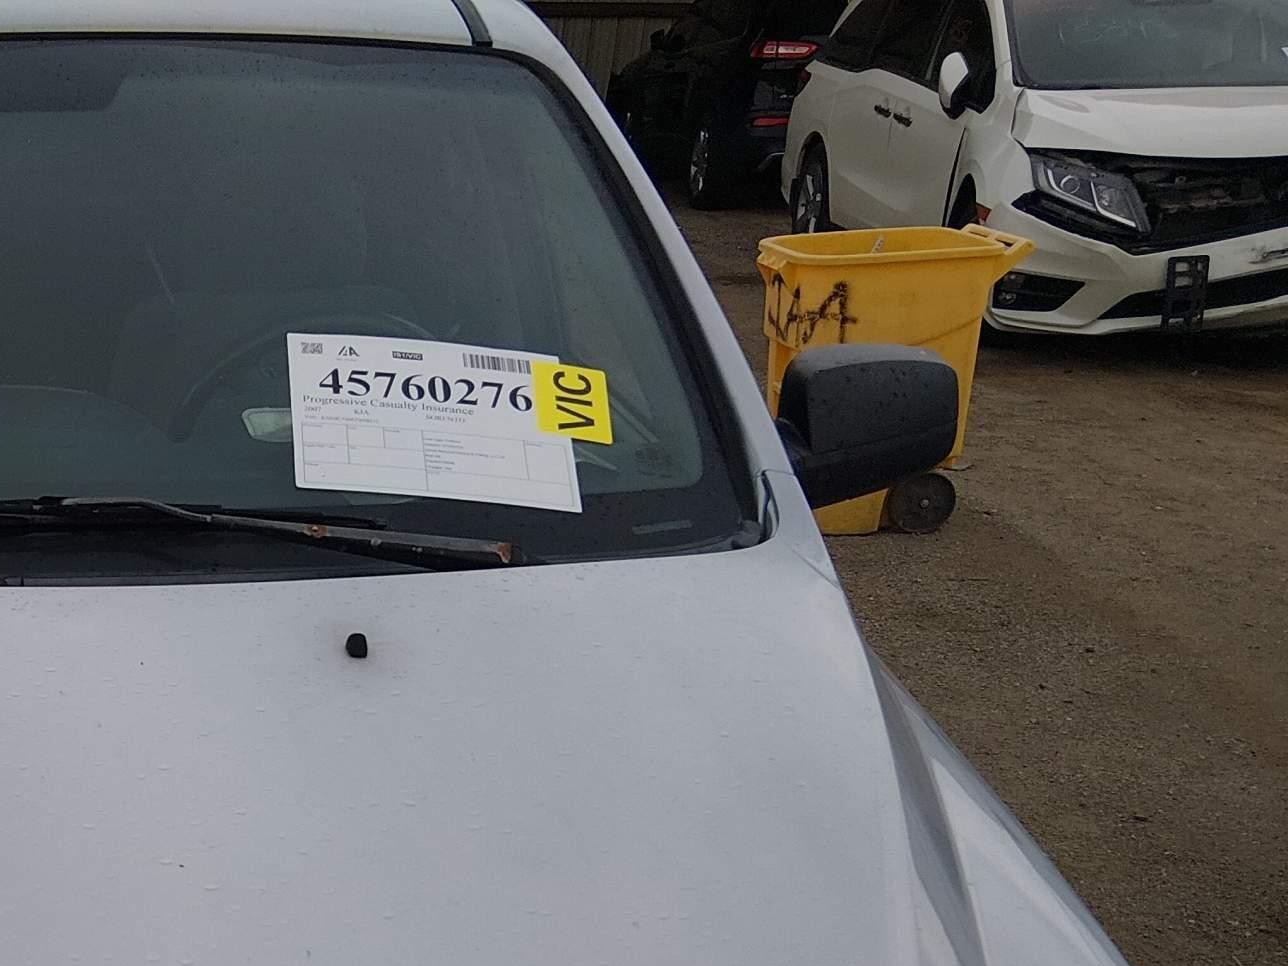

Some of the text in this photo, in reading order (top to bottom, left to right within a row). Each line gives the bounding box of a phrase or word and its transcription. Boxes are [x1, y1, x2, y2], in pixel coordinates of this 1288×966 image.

[303, 395, 474, 415] Progressive Casualty Insurance
[319, 368, 533, 412] 45760276
[552, 371, 595, 431] VIC
